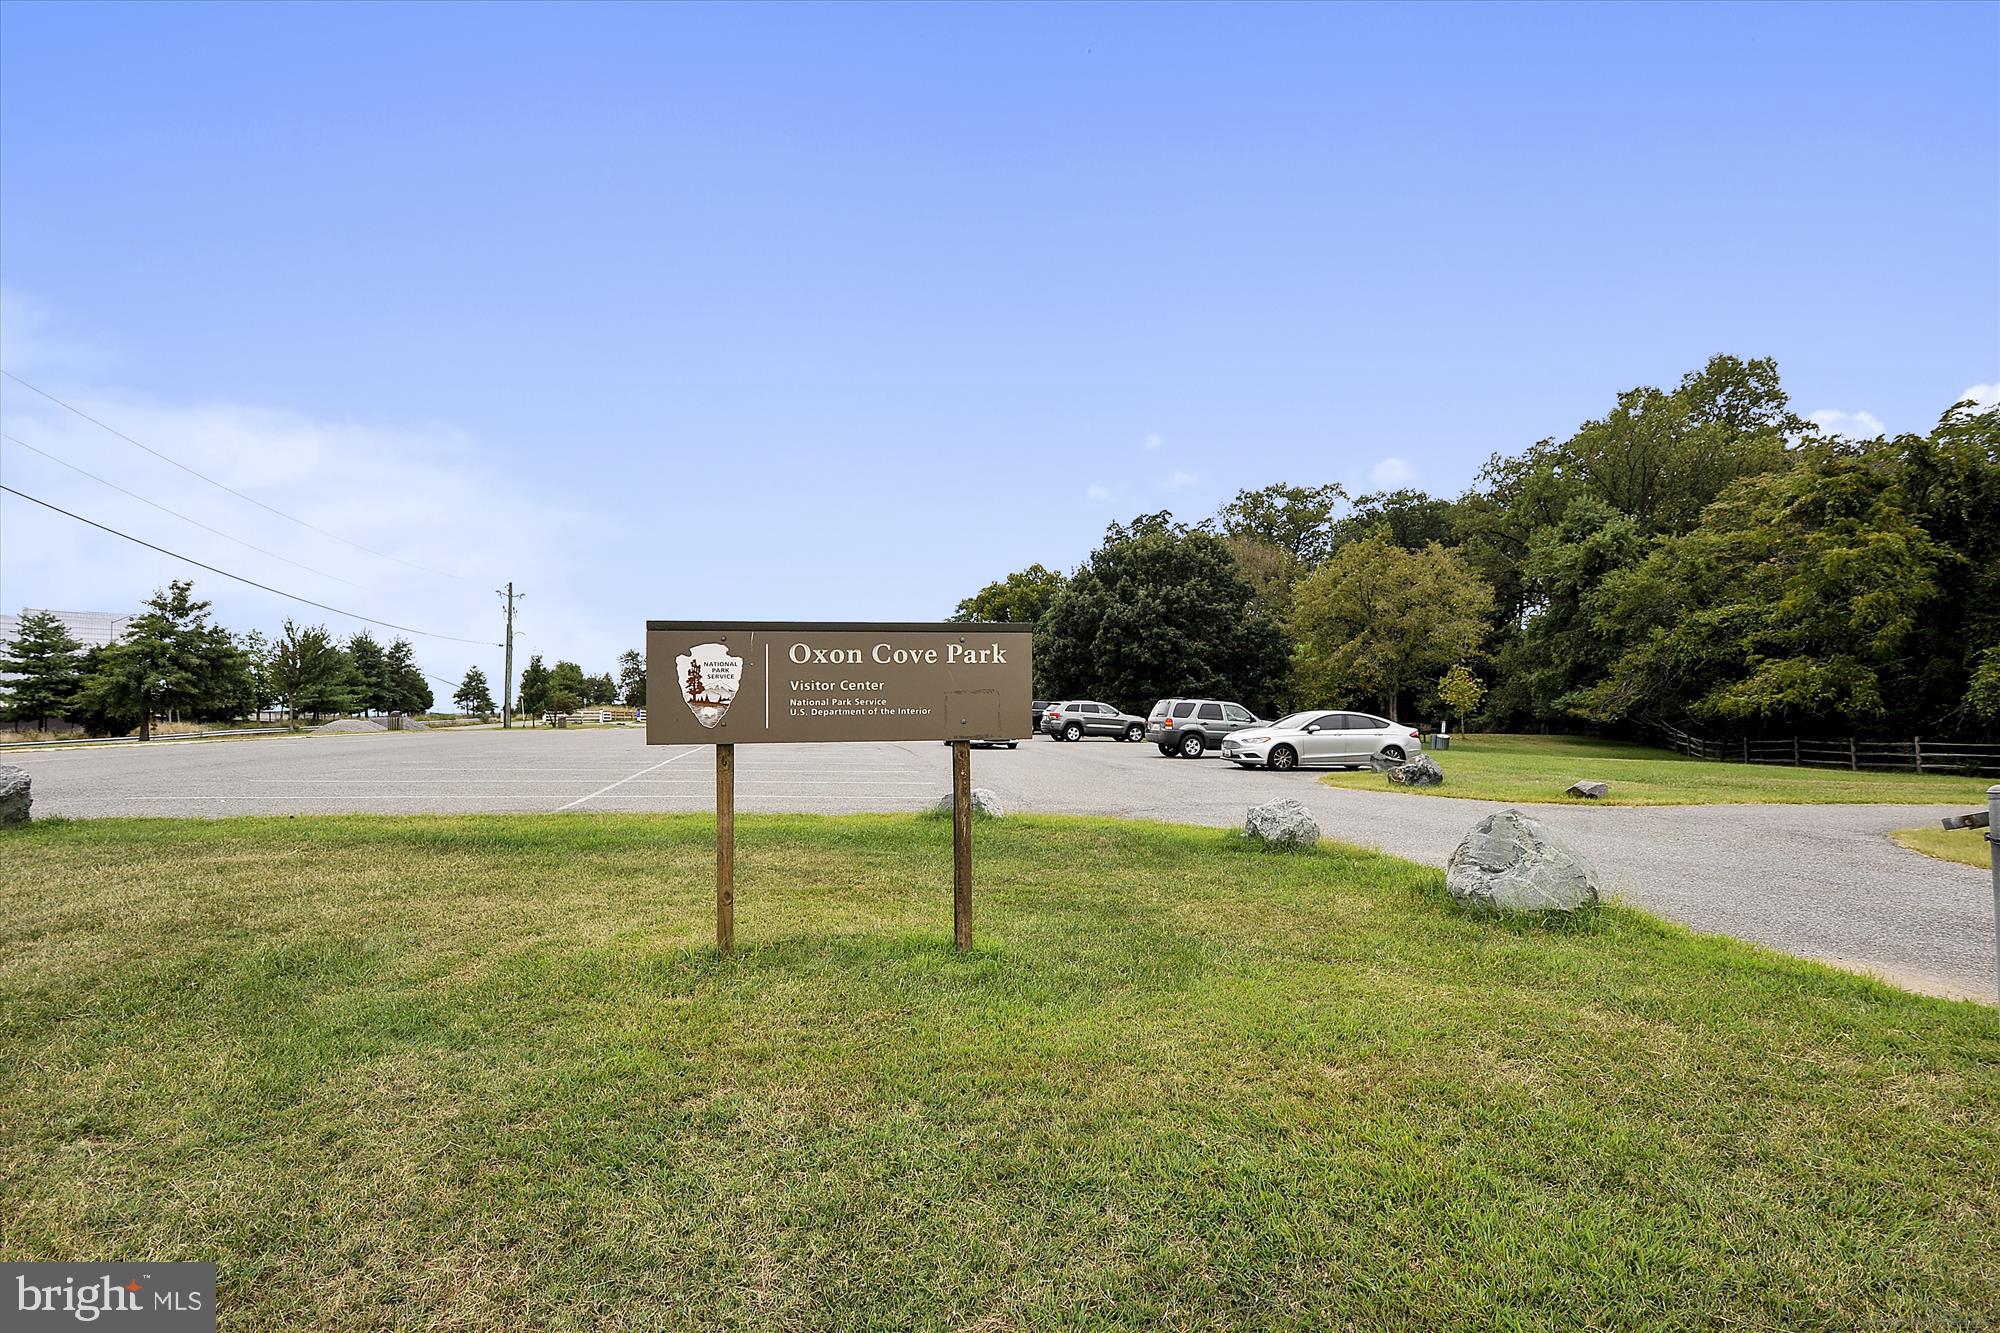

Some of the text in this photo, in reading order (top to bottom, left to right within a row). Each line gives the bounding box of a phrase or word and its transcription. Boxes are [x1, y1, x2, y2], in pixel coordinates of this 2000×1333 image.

[788, 642, 1007, 665] Oxon Cove Park
[789, 680, 885, 691] Visitor Center
[789, 698, 887, 706] National Park Service
[789, 707, 931, 717] U.S. Department of the Interior
